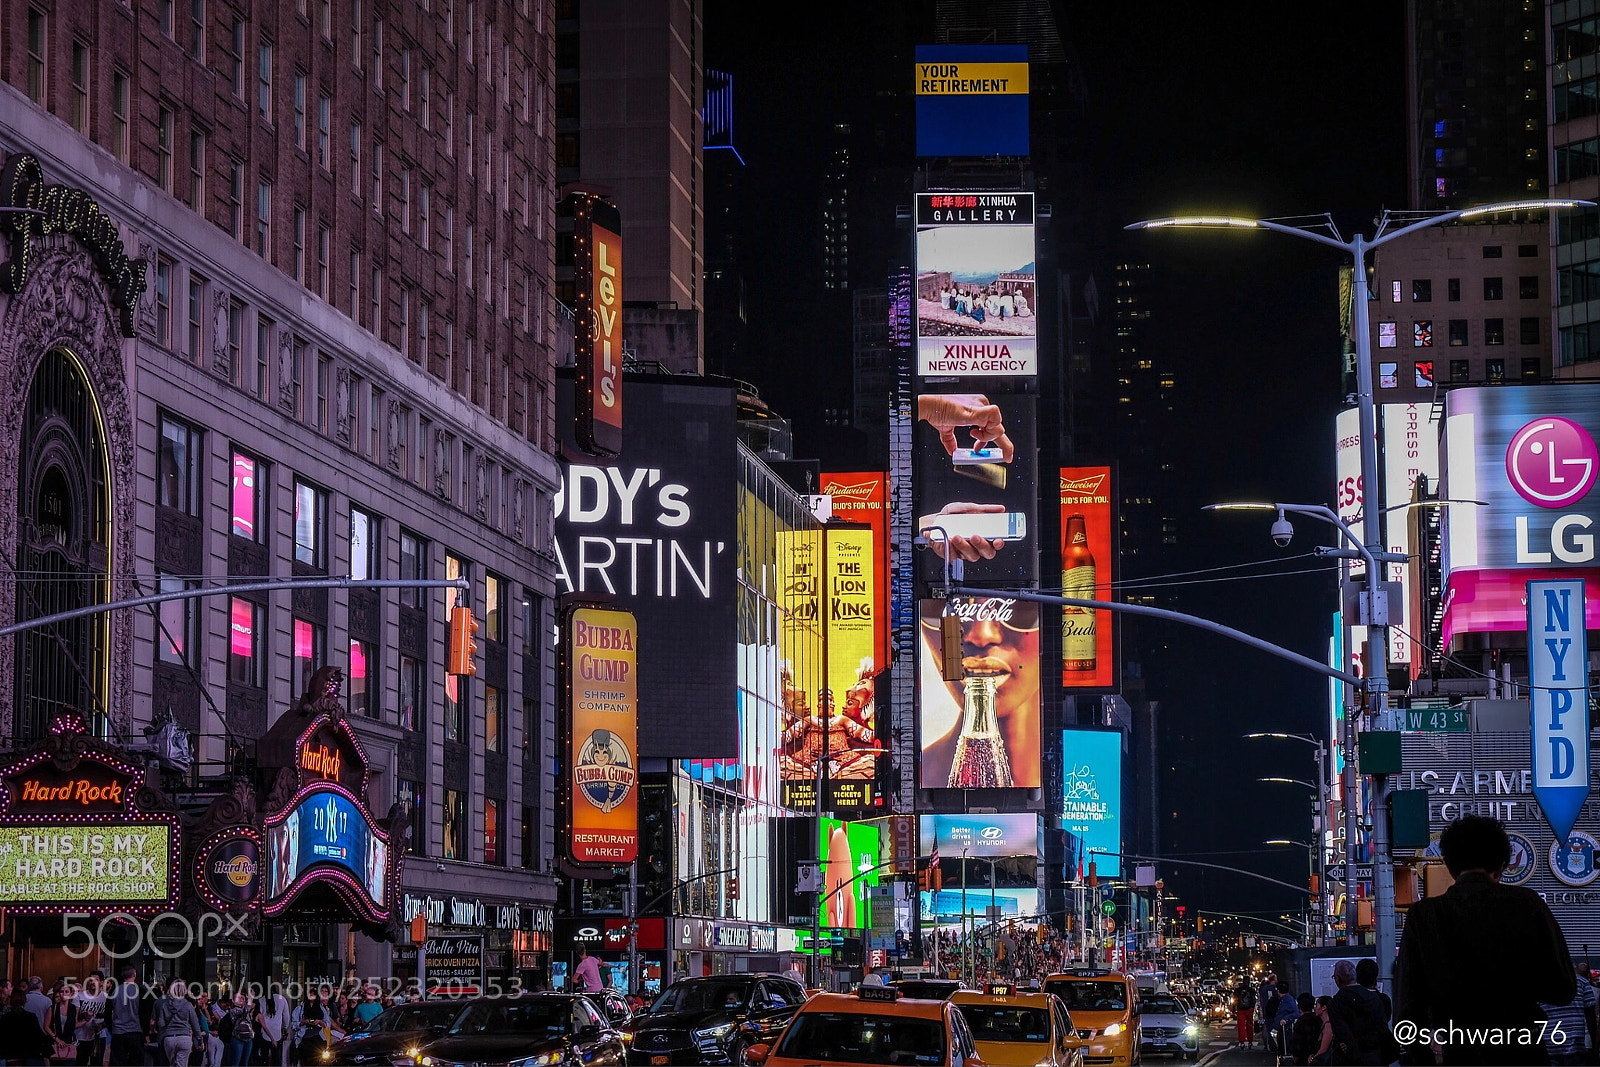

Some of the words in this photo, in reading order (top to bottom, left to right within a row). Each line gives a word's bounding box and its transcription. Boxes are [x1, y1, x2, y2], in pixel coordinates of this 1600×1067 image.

[920, 65, 958, 78] YOUR
[920, 79, 1008, 92] RETIREMENT
[978, 196, 1017, 207] XINHUA
[933, 210, 1017, 222] GALLERY
[944, 344, 1012, 359] XINHUA
[928, 360, 968, 371] NEWS
[971, 360, 1027, 372] AGENCY
[824, 485, 872, 495] Budweiser
[866, 502, 882, 510] YOU.
[1515, 514, 1594, 564] LG
[834, 542, 862, 552] Disney
[837, 562, 860, 574] THE
[834, 576, 866, 596] LION
[832, 598, 871, 620] KING
[575, 619, 634, 652] BUBBA
[579, 653, 630, 684] GUMP
[1544, 589, 1574, 780] NYPD
[584, 690, 626, 700] SHRIMP
[578, 701, 631, 712] COMPANY
[1410, 712, 1422, 728] W
[1430, 712, 1447, 728] 43
[1454, 711, 1464, 723] St
[301, 742, 322, 772] Hard
[321, 746, 340, 780] Rock
[577, 768, 606, 782] BUBBA
[608, 766, 633, 784] GUMP
[22, 780, 72, 800] Hard
[75, 780, 122, 804] Rock
[314, 807, 324, 830] 20
[340, 811, 348, 834] 17
[1062, 812, 1104, 821] GENERATION
[18, 834, 74, 855] THIS
[82, 834, 105, 855] IS
[112, 834, 148, 854] MY
[574, 834, 636, 844] RESTAURANT
[586, 848, 624, 858] MARKET
[16, 858, 82, 878] HARD
[90, 857, 156, 877] ROCK
[214, 860, 241, 874] Hard
[44, 884, 58, 894] AT
[62, 883, 84, 893] THE
[88, 882, 120, 892] ROCK
[124, 882, 156, 892] SHOP
[452, 896, 474, 925] SHRIMP
[424, 940, 454, 954] Bella
[456, 940, 481, 954] Vita
[443, 958, 461, 968] OVEN
[462, 958, 480, 967] PIZZA
[992, 987, 1008, 995] 1P97
